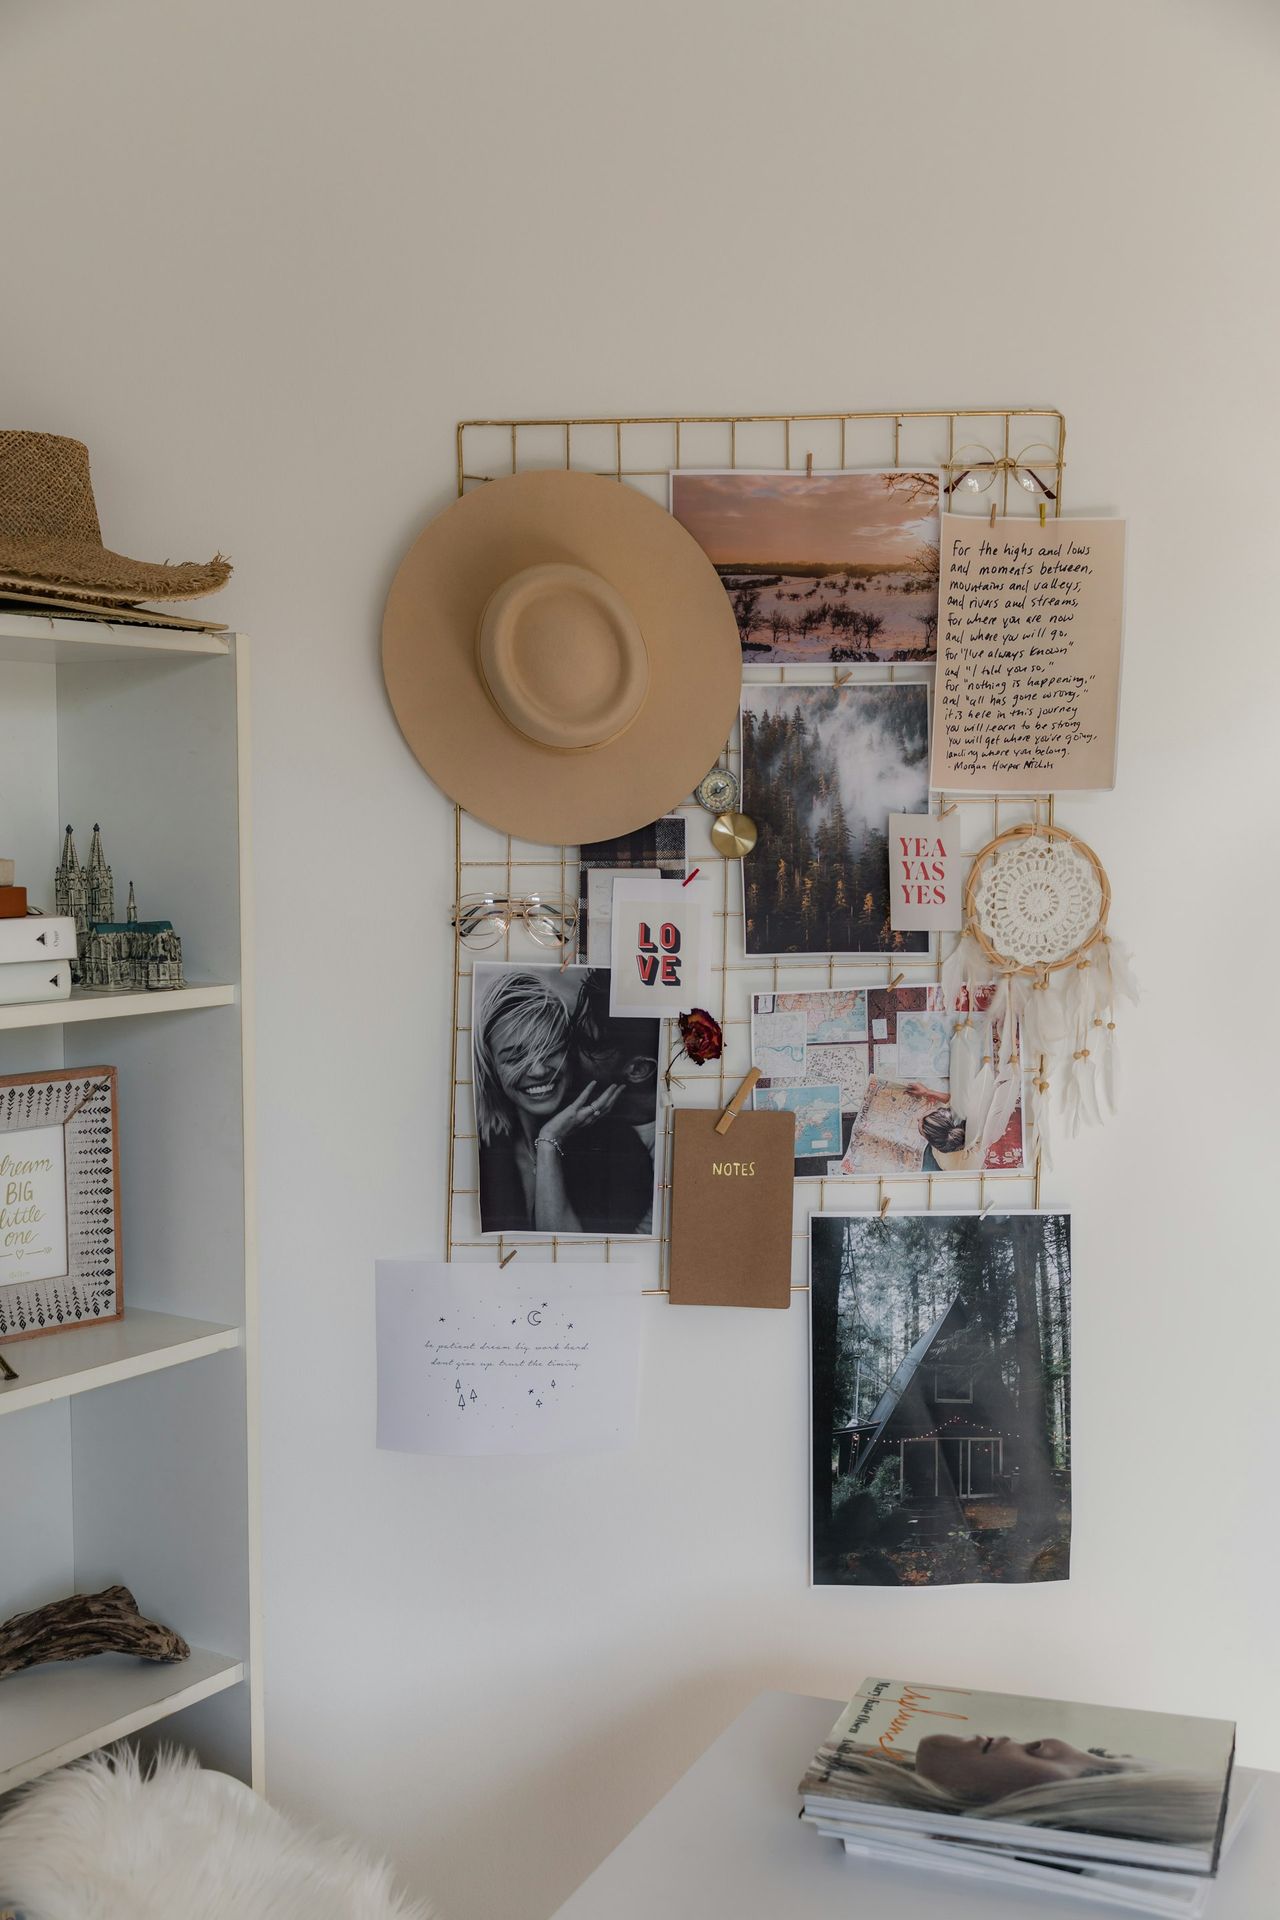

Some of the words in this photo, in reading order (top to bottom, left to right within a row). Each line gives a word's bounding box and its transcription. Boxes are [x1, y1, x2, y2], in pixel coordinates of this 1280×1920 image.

[953, 540, 970, 557] For
[979, 540, 998, 556] the
[1004, 543, 1033, 561] highs
[1038, 543, 1062, 556] and
[1067, 541, 1090, 555] lows
[950, 561, 970, 575] and
[979, 563, 1033, 575] moments
[1040, 562, 1093, 575] between,
[950, 581, 1004, 592] mountains
[1009, 580, 1029, 593] and
[1034, 578, 1081, 594] valleys,
[947, 595, 965, 610] and
[970, 597, 998, 609] rivers
[1005, 595, 1028, 609] and
[1031, 594, 1079, 608] streams,
[967, 613, 996, 625] where
[1003, 617, 1020, 628] you
[1026, 614, 1042, 623] are
[1050, 613, 1074, 623] now
[945, 631, 962, 643] and
[970, 629, 997, 641] where
[1002, 634, 1018, 645] you
[1022, 627, 1045, 639] will
[988, 650, 1024, 661] always
[945, 666, 960, 678] and
[981, 665, 1001, 674] told
[1007, 666, 1027, 676] you
[1012, 678, 1020, 688] is
[943, 695, 959, 706] and
[990, 694, 1006, 705] has
[1012, 692, 1038, 707] gone
[968, 708, 991, 718] here
[997, 708, 1005, 719] in
[1010, 707, 1033, 717] this
[1038, 704, 1078, 719] journey
[945, 724, 959, 735] you
[964, 722, 983, 732] will
[986, 722, 1016, 731] learn
[1021, 720, 1031, 730] to
[1035, 721, 1049, 731] be
[1052, 720, 1081, 732] strong
[965, 735, 983, 744] will
[985, 734, 1000, 748] get
[1003, 734, 1031, 743] where
[946, 749, 979, 763] landing
[981, 748, 1009, 757] where
[1013, 749, 1032, 757] you
[954, 762, 987, 775] Morgan
[992, 760, 1020, 771] Harper
[899, 837, 947, 857] YEA
[901, 861, 945, 881] YAS
[901, 885, 946, 905] YES
[637, 922, 681, 954] LO
[636, 954, 682, 986] VE
[712, 1161, 755, 1176] NOTES
[6, 1181, 34, 1205] BIG
[0, 1204, 47, 1229] little
[4, 1229, 40, 1248] one
[479, 1342, 510, 1350] dream
[527, 1359, 543, 1367] the
